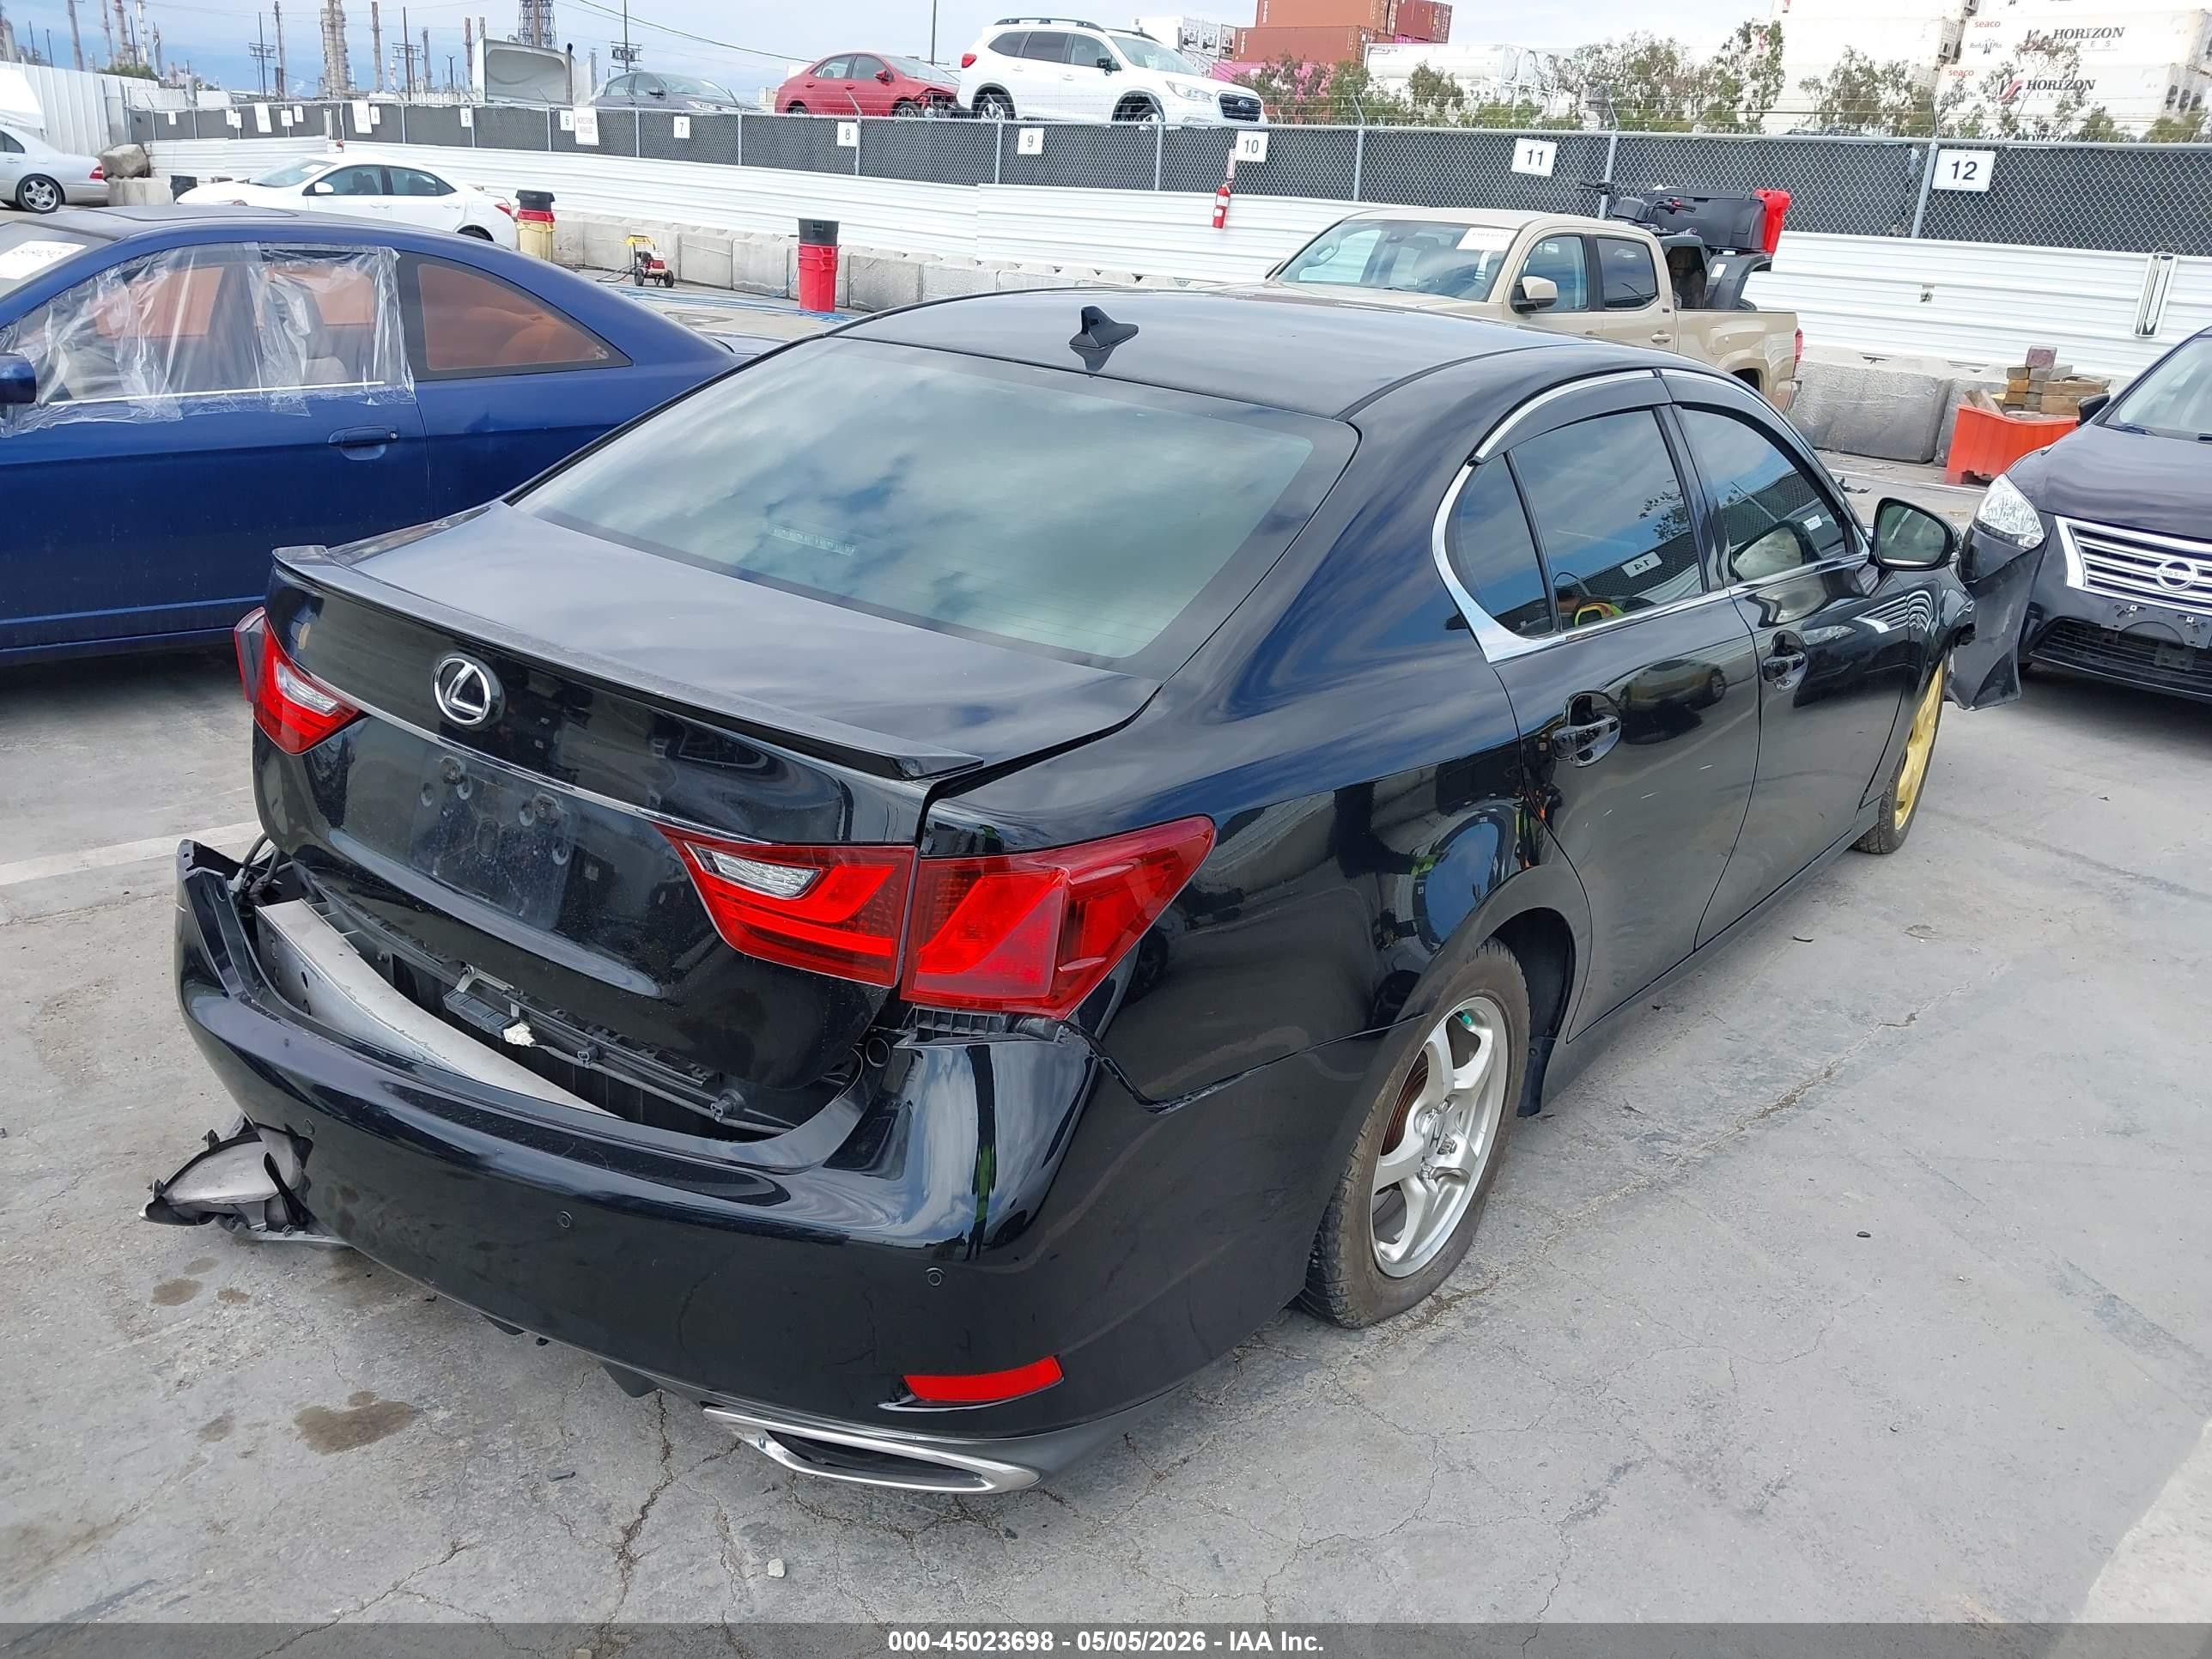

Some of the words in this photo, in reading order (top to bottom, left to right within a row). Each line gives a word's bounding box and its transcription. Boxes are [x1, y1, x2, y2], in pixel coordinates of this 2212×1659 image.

[1973, 20, 2002, 28] seaco
[2052, 27, 2125, 40] HORIZON
[1948, 68, 1975, 77] seaco
[2025, 79, 2097, 91] HORIZON
[565, 115, 570, 126] 6
[679, 122, 684, 133] 7
[845, 128, 851, 141] 8
[1027, 134, 1035, 148] 9
[1244, 138, 1260, 155] 10
[1527, 148, 1545, 167] 11
[1950, 160, 1978, 181] 12
[2158, 568, 2192, 580] NISSAN
